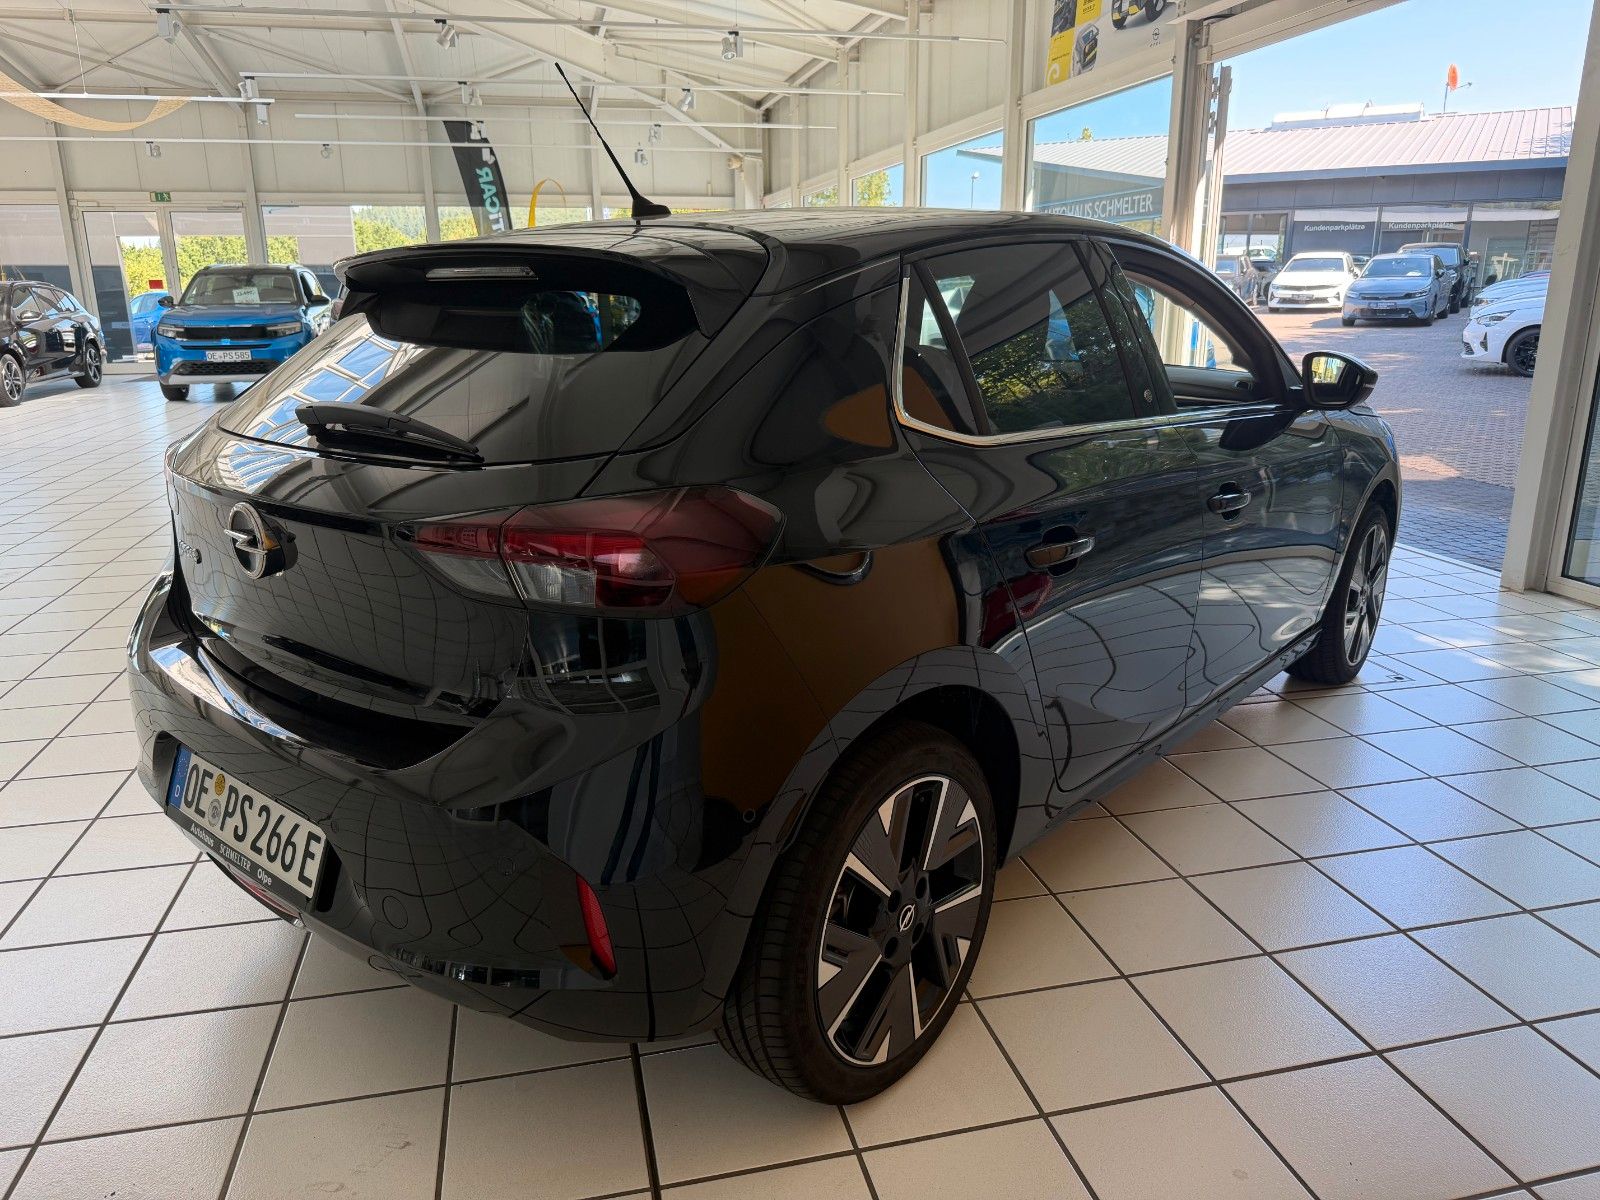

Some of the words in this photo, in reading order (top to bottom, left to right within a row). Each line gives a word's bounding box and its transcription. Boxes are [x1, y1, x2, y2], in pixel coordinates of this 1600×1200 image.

[1041, 202, 1092, 218] TOHAUS
[1093, 194, 1153, 218] SCHMELTER
[1303, 224, 1366, 233] Kundenparkplätze
[183, 763, 214, 819] OE
[190, 822, 215, 848] Autohaus
[219, 843, 252, 872] SCHMELTER
[257, 869, 272, 886] Olpe
